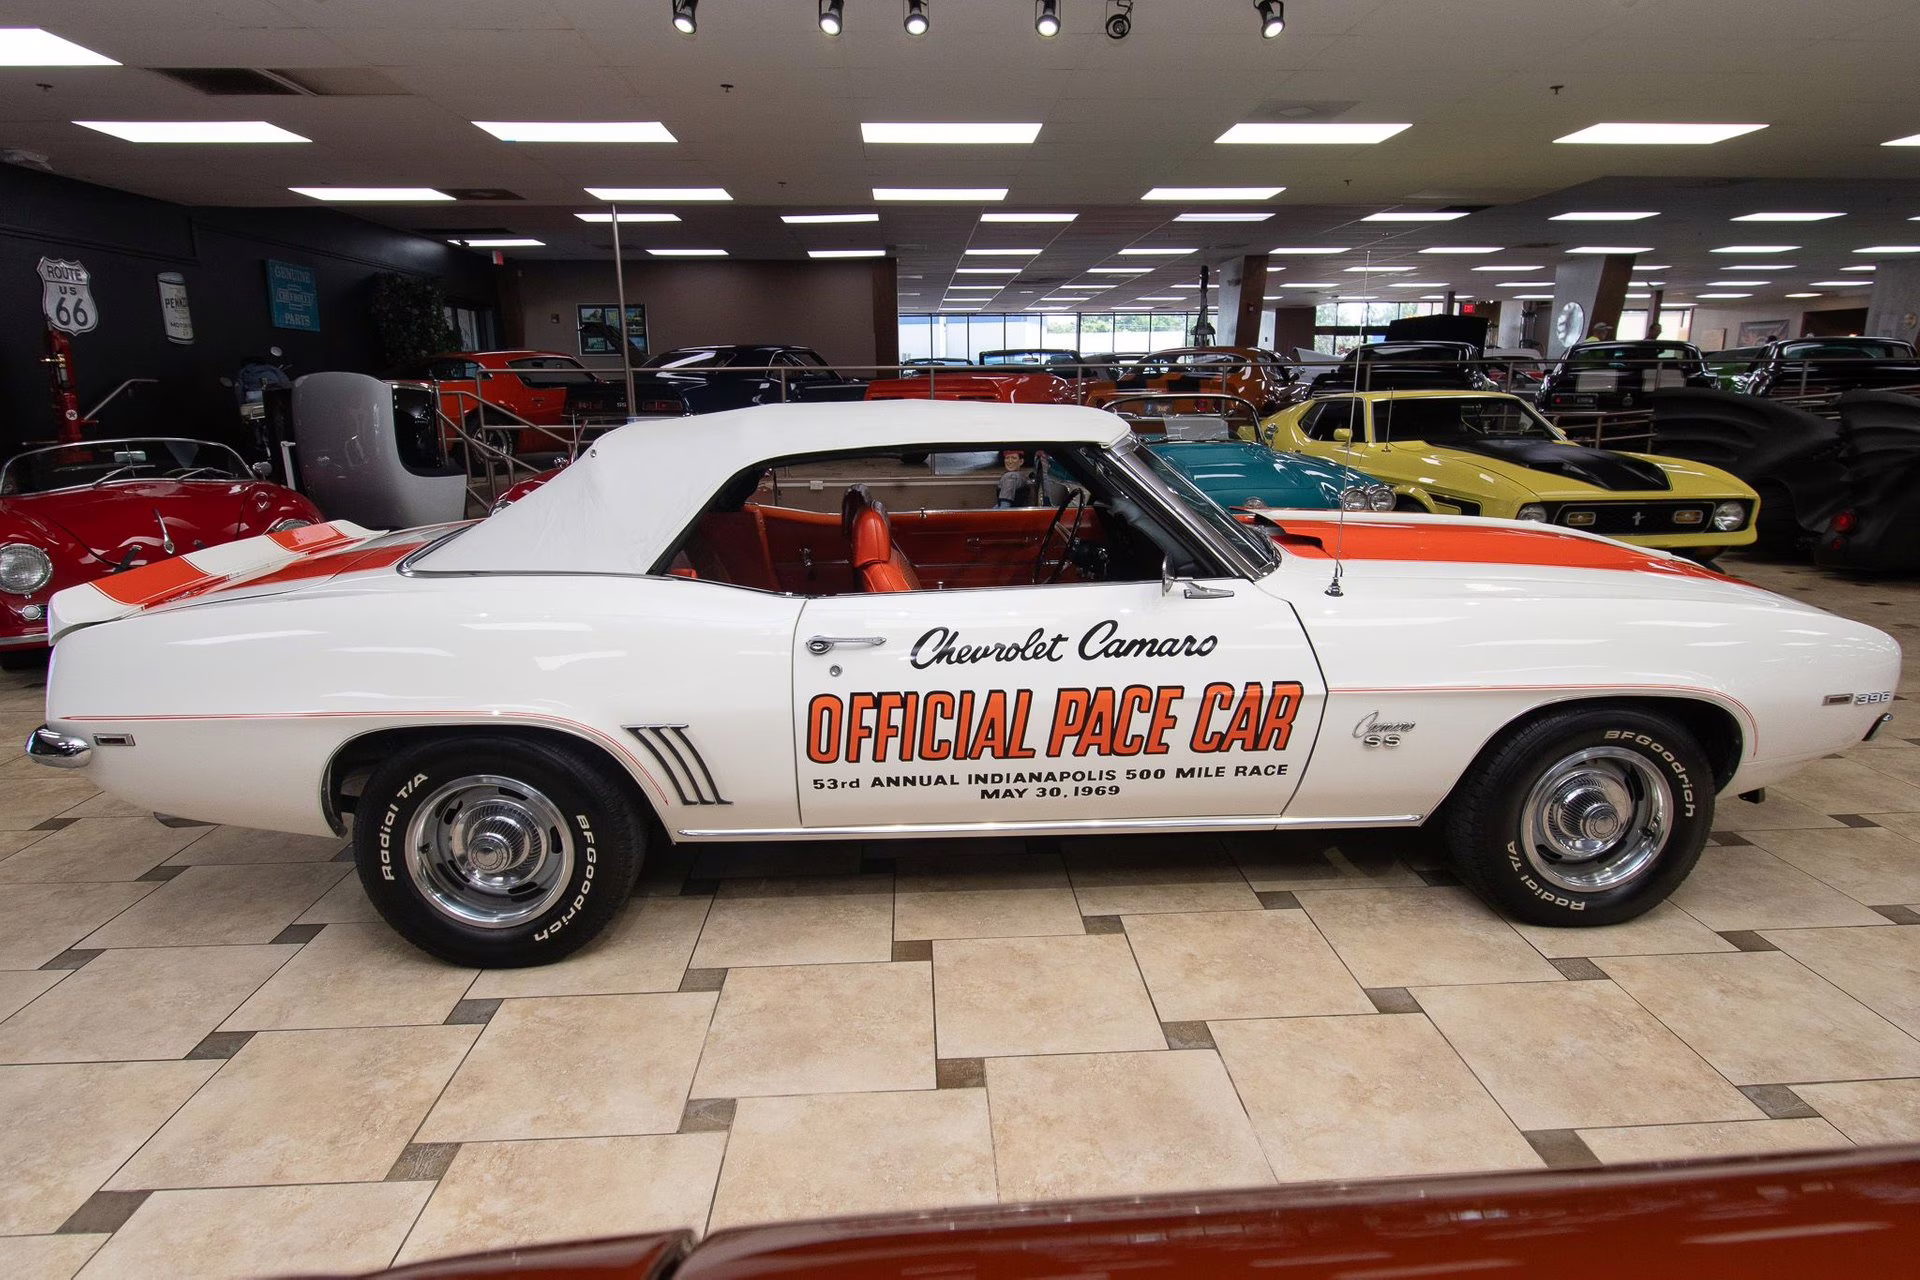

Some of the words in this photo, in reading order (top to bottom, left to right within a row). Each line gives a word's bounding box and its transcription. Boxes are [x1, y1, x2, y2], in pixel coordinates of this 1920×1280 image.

[46, 265, 82, 281] ROUTE
[274, 265, 311, 283] GENUINE
[59, 285, 77, 295] US
[56, 297, 88, 326] 66
[284, 312, 312, 328] PARTS
[910, 626, 1068, 670] Chevrolet
[1077, 619, 1219, 661] Camaro
[1855, 691, 1892, 705] 396
[806, 690, 1035, 763] OFFICIAL
[1045, 686, 1184, 758] PACE
[1189, 681, 1304, 753] CAR
[1352, 710, 1416, 738] Camaro
[1363, 734, 1401, 748] SS
[813, 779, 860, 790] 53rd
[871, 775, 960, 788] ANNUAL
[967, 770, 1117, 785] INDIANAPOLIS
[1125, 768, 1166, 780] 500
[1175, 766, 1225, 779] MILE
[1234, 764, 1289, 777] RACE
[1603, 730, 1695, 817] BFGoodrich
[980, 787, 1029, 799] MAY
[379, 803, 400, 880] Radial
[396, 772, 429, 799] T/A
[1506, 840, 1522, 872] T/A
[534, 814, 597, 942] BFGoodrich
[1520, 874, 1586, 911] Radial
